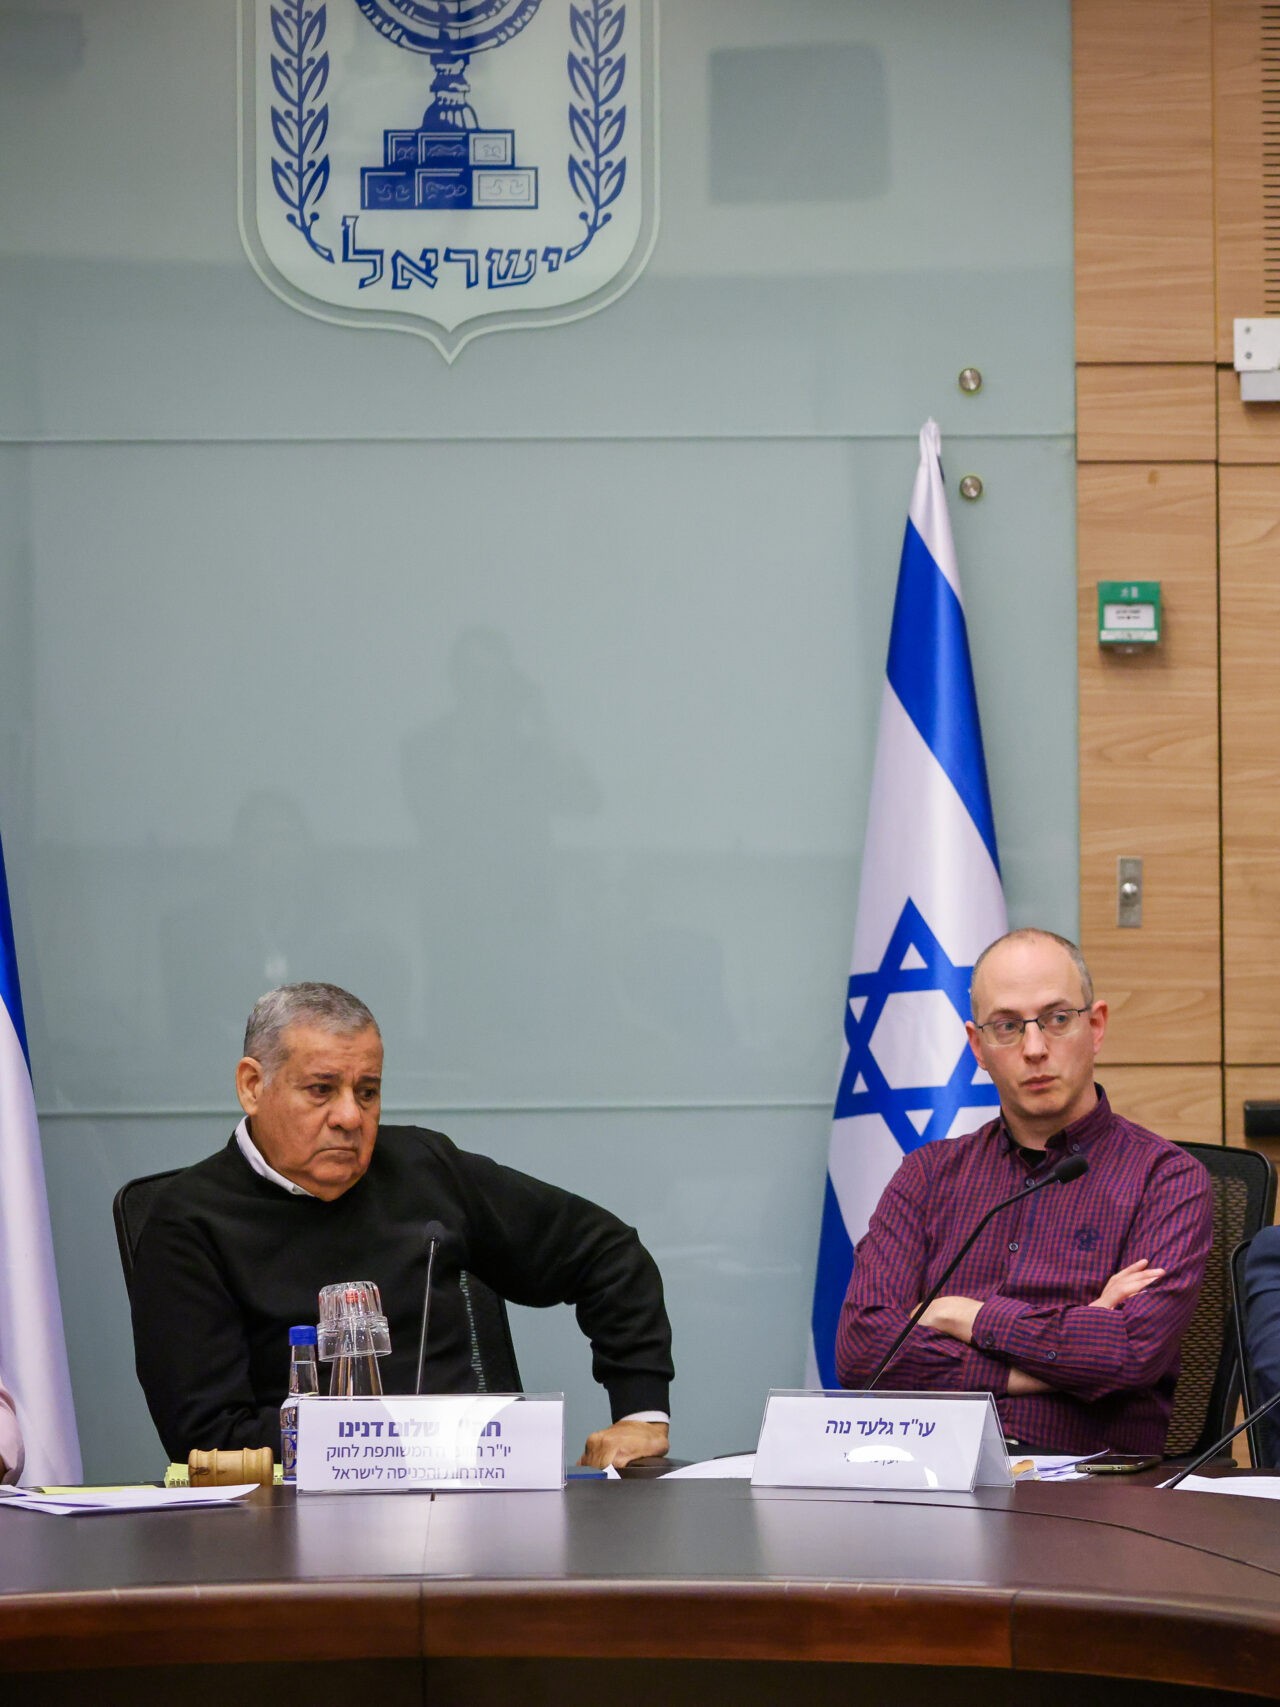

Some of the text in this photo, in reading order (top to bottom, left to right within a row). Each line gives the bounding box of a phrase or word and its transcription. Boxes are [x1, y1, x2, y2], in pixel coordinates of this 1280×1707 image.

[341, 215, 563, 290] ישראל
[338, 1420, 384, 1438] דנינו
[388, 1417, 440, 1438] שלום
[825, 1417, 936, 1437] עו"ד גלעד נוה
[326, 1443, 359, 1462] לחוק
[363, 1444, 432, 1459] המשותפת
[488, 1444, 512, 1458] יו"ר
[332, 1465, 383, 1480] לישראל
